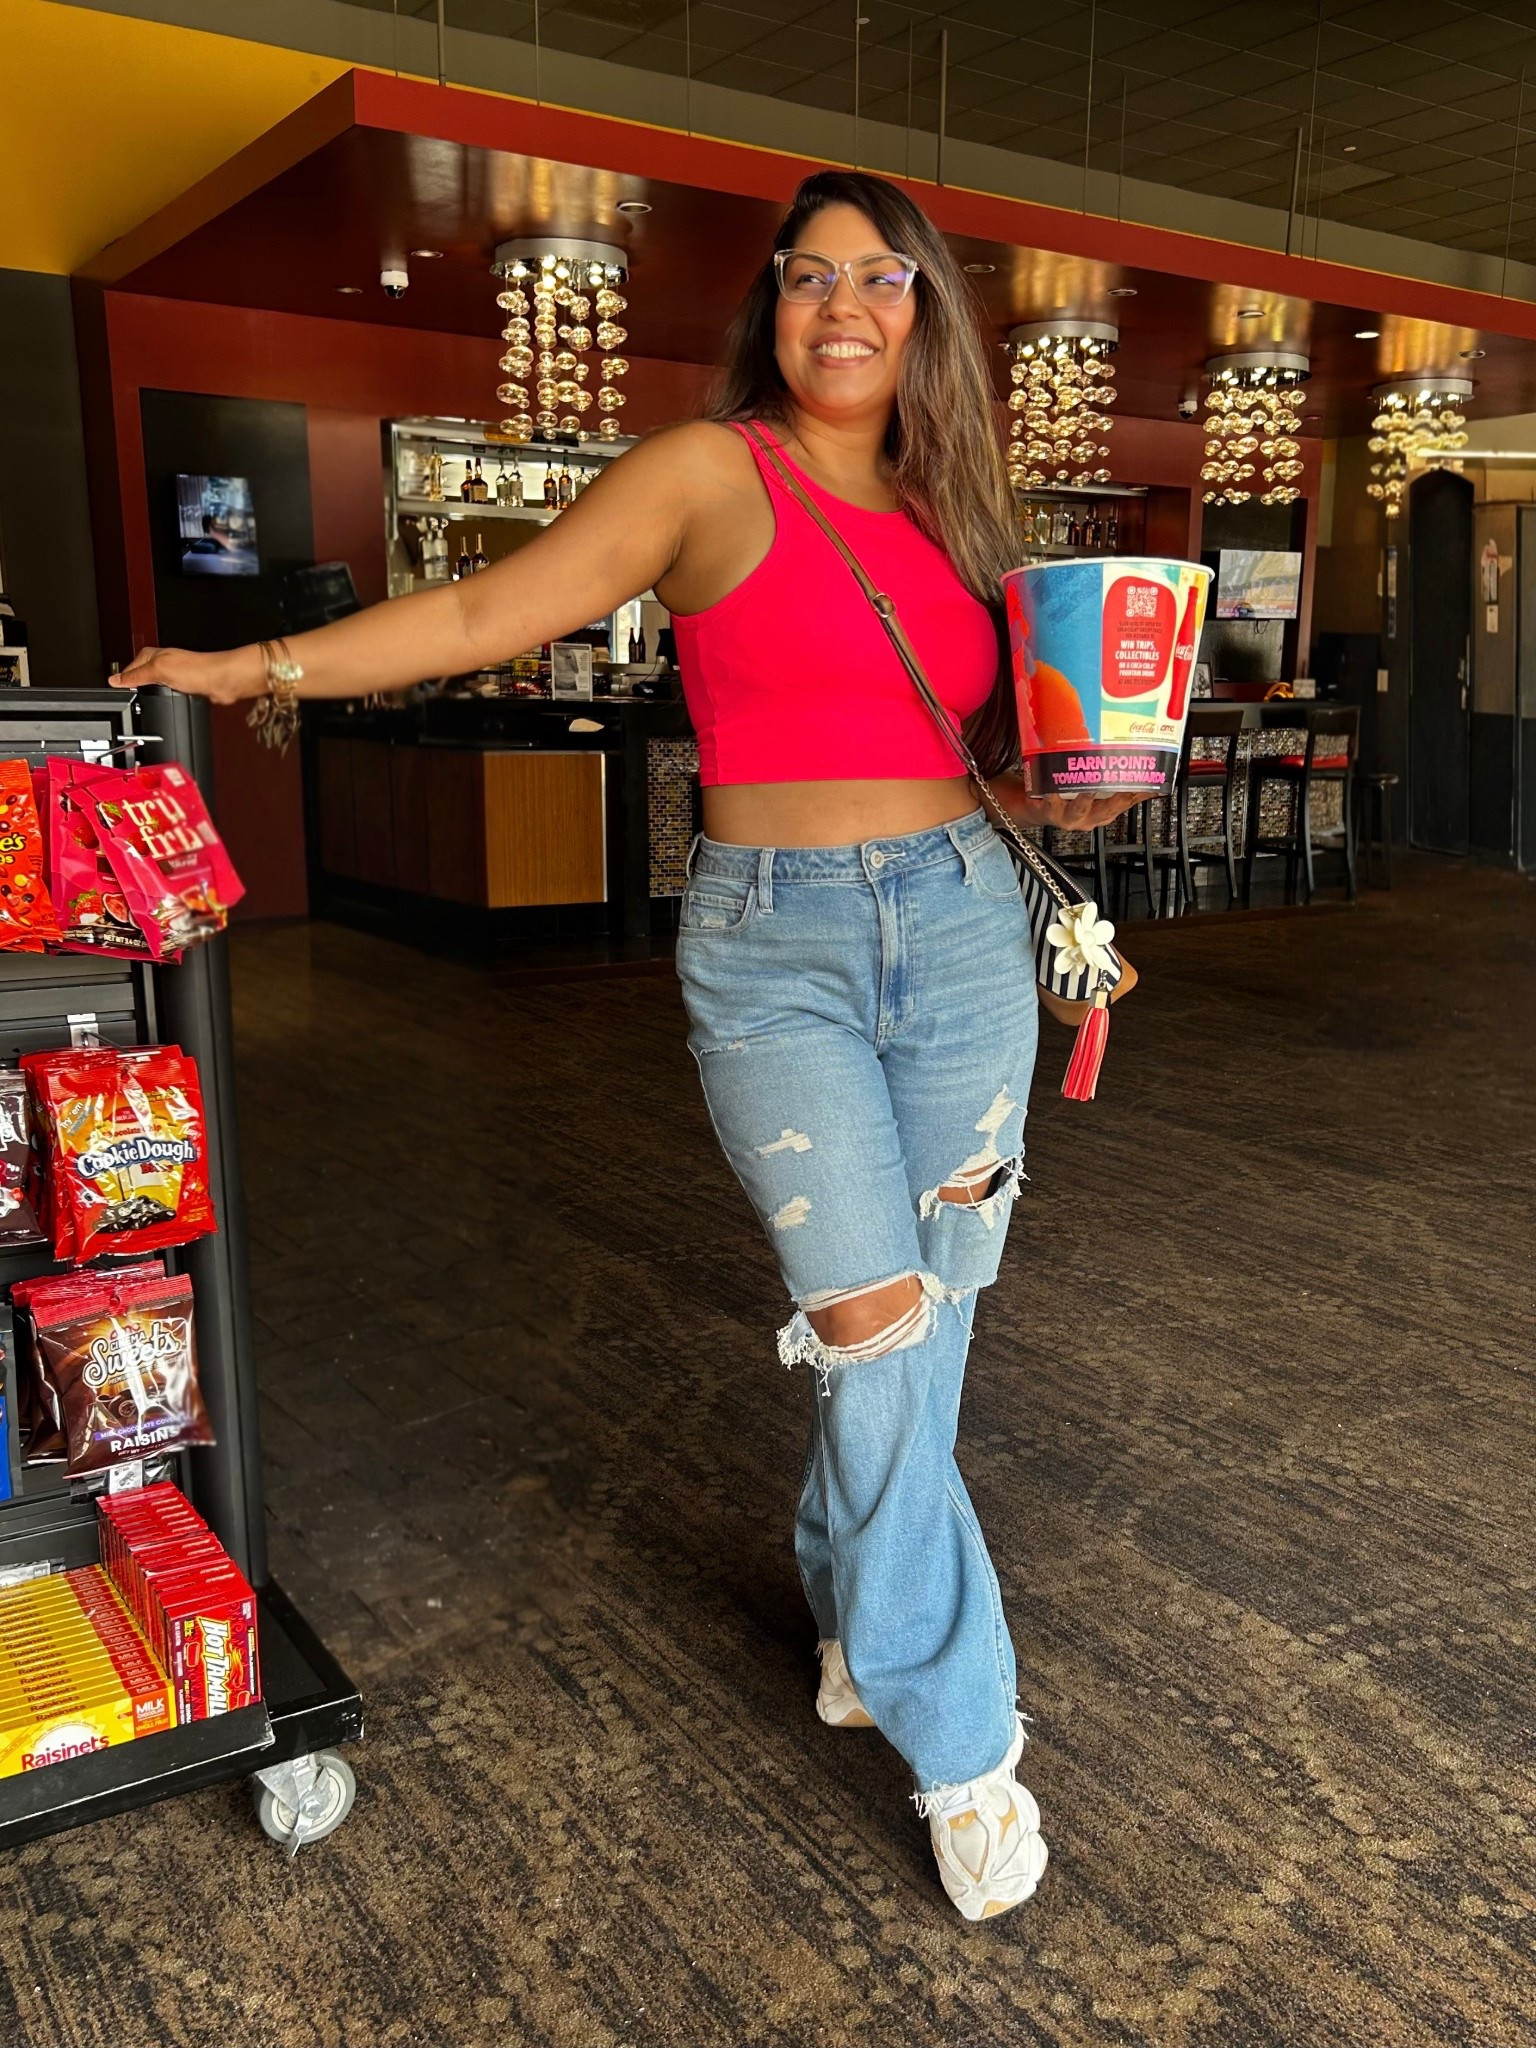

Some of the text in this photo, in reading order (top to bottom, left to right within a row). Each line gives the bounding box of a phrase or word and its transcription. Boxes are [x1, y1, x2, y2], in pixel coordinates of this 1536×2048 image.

[1121, 640, 1134, 649] WIN
[1115, 650, 1159, 661] COLLECTIBLES
[1067, 755, 1157, 771] EARN POINTS
[1052, 771, 1101, 785] TOWARD
[1103, 770, 1118, 784] $5
[60, 1117, 73, 1129] Try
[83, 1320, 181, 1387] Sweets
[111, 1424, 181, 1452] RAISINS
[115, 1642, 136, 1651] MILK
[199, 1619, 229, 1658] HOT
[14, 1652, 62, 1667] Raisinets
[117, 1651, 140, 1660] MILK
[18, 1660, 66, 1676] Raisinets
[121, 1659, 144, 1669] MILK
[126, 1667, 149, 1676] MILK
[20, 1669, 69, 1685] Raisinets
[129, 1675, 152, 1685] MILK
[23, 1677, 72, 1694] Raisinets
[136, 1684, 158, 1693] MILK
[27, 1686, 77, 1702] Raisinets
[30, 1695, 80, 1712] Raisinets
[136, 1697, 165, 1715] MILK
[36, 1704, 87, 1722] Raisinets
[21, 1734, 110, 1770] Raisinets
